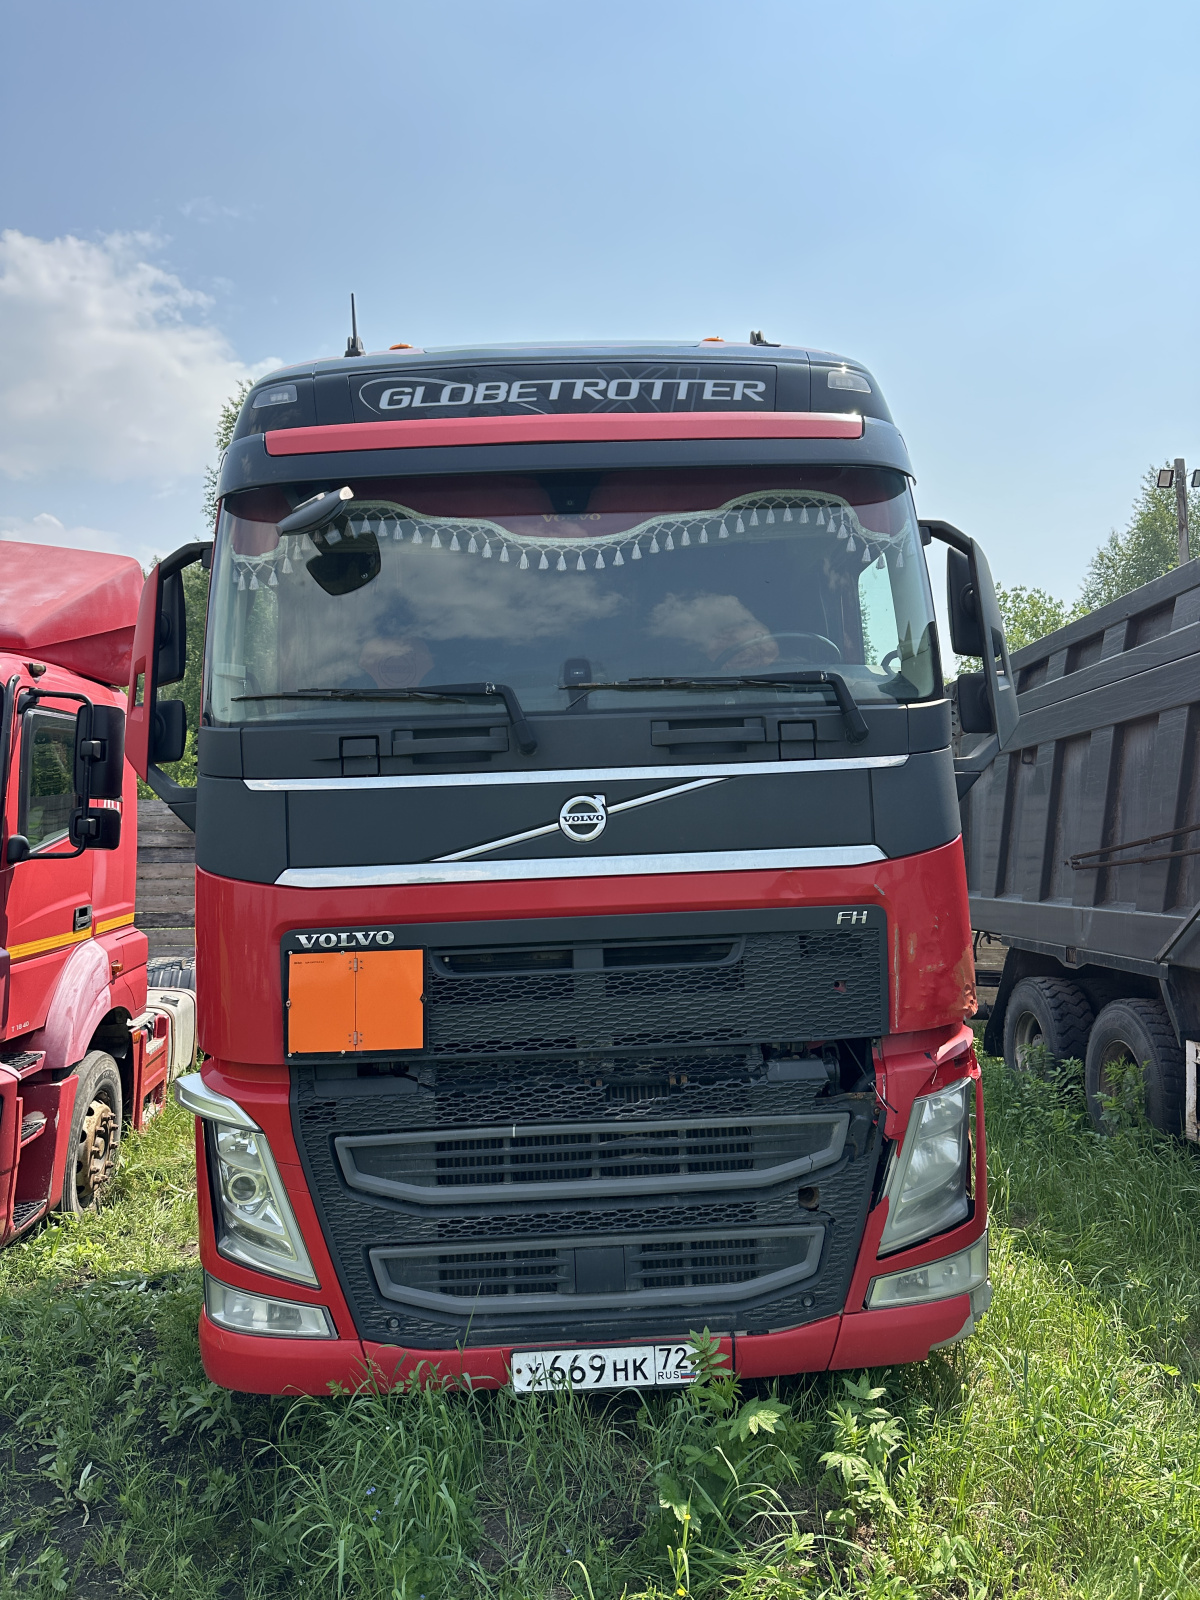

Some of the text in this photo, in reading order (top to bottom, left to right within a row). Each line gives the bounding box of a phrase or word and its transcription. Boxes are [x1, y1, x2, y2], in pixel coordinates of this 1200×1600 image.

[378, 378, 766, 410] GLOBETROTTER
[562, 814, 604, 822] VOLVO
[836, 910, 868, 925] FH
[295, 930, 395, 948] VOLVO
[658, 1347, 688, 1370] 72
[657, 1370, 680, 1380] RUS
